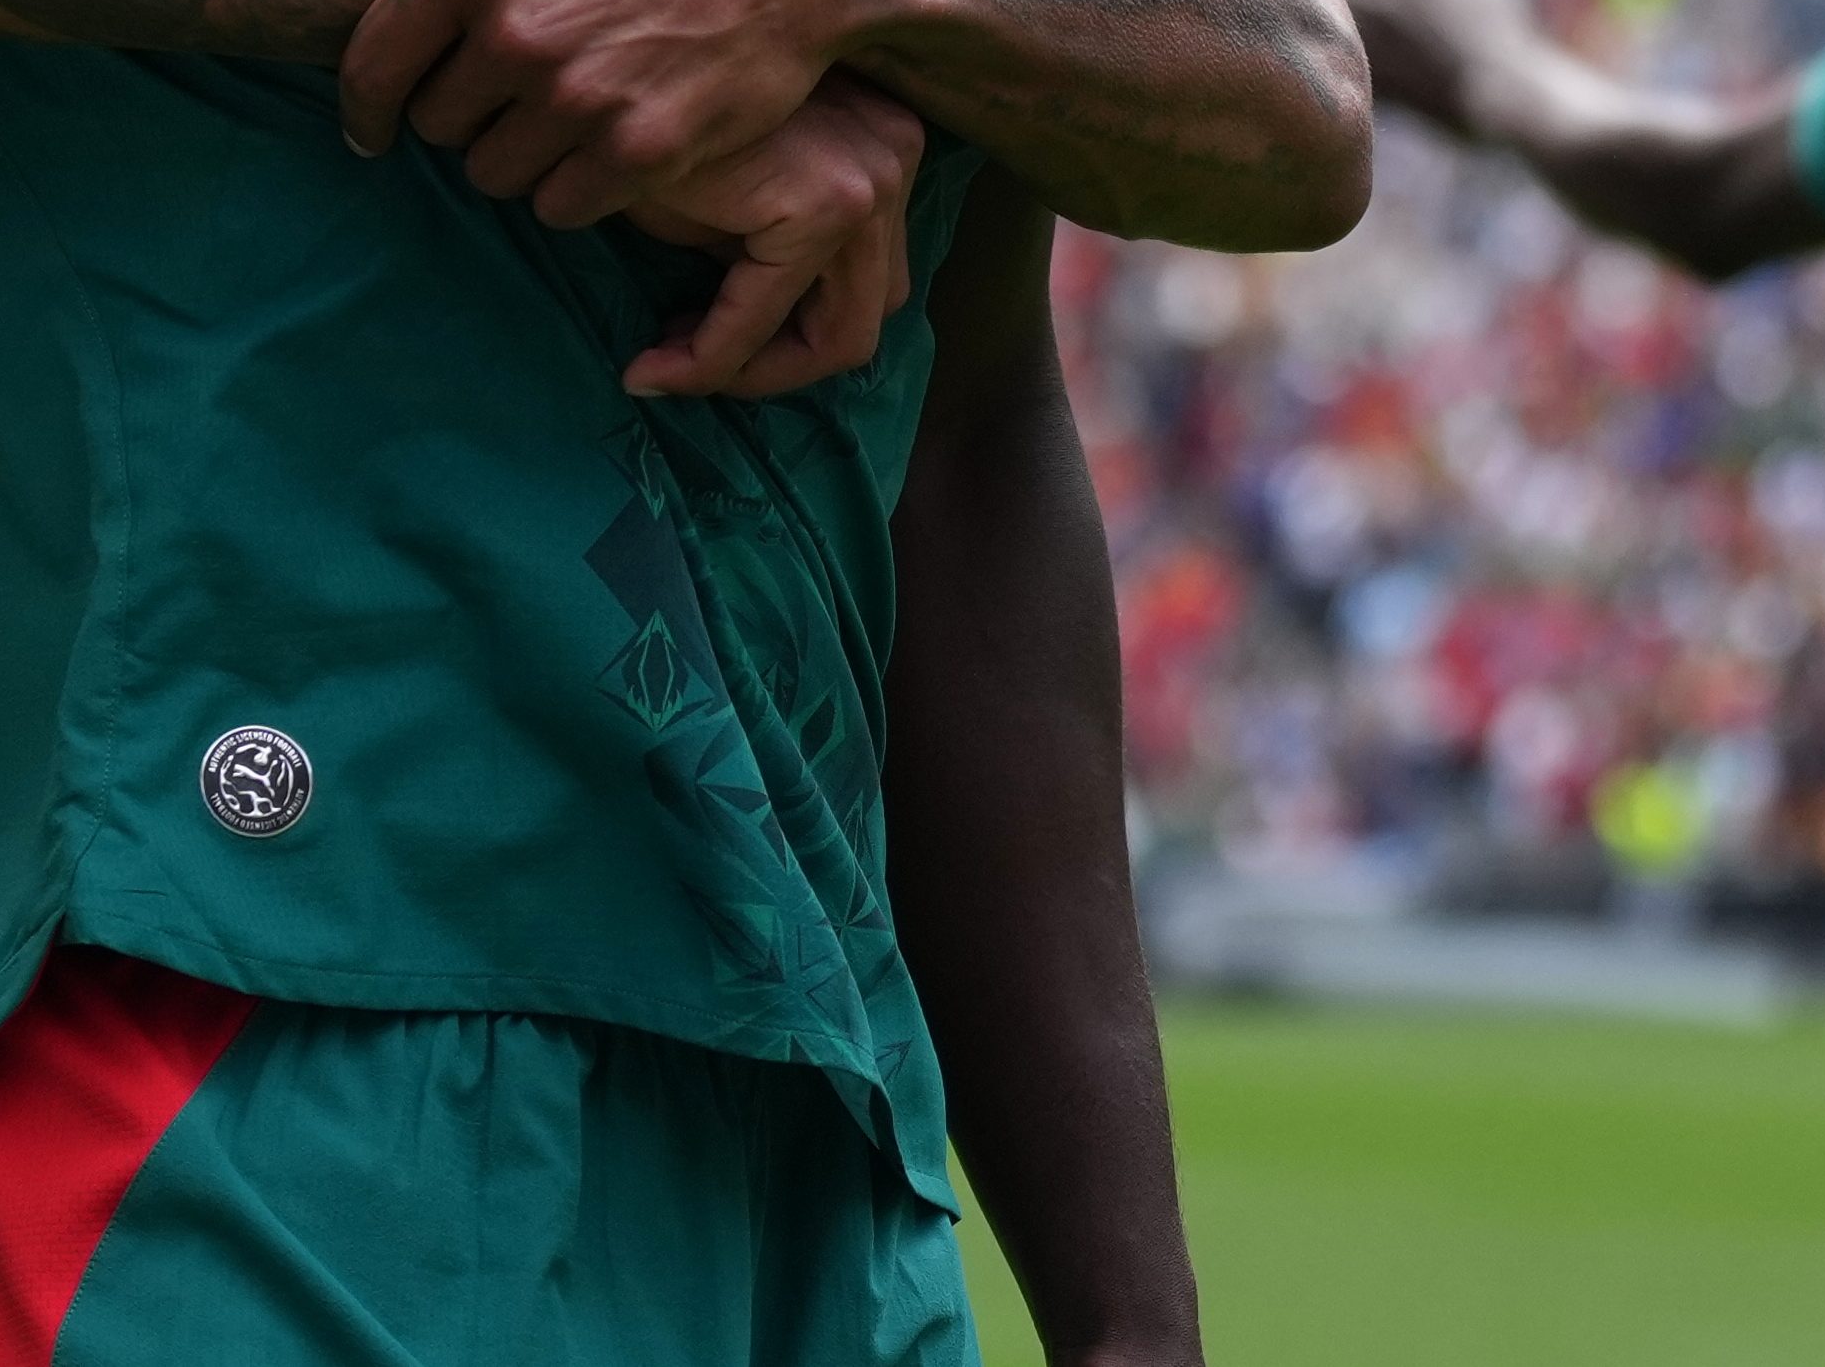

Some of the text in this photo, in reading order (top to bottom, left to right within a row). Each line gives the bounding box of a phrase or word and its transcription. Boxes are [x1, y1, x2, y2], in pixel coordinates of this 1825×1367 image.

[208, 731, 302, 773] AUTHENTIC LICENSED FOOTBALL
